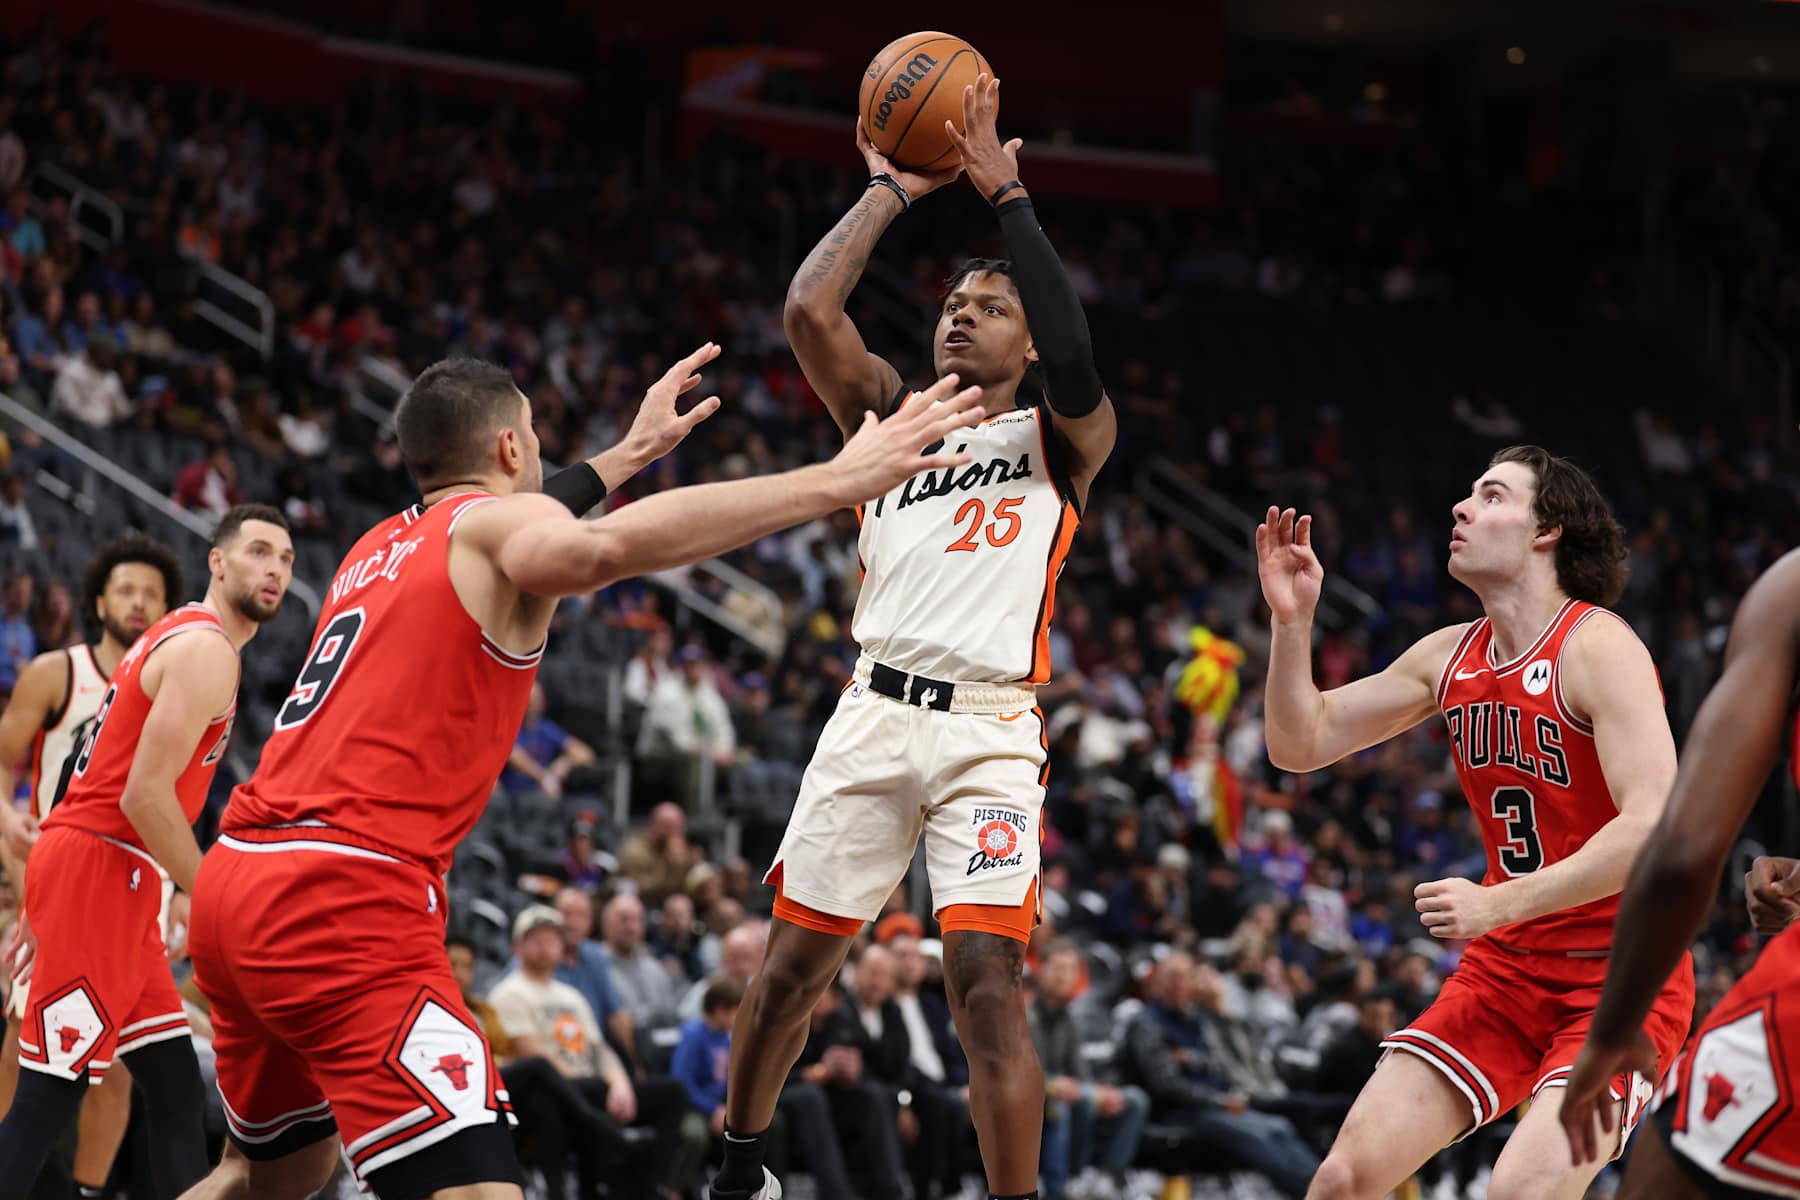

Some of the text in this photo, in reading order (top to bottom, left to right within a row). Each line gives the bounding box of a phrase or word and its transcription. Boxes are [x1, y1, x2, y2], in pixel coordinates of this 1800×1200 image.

[874, 53, 939, 131] Wilson
[944, 495, 1026, 553] 25
[274, 605, 366, 731] 9
[1445, 700, 1572, 788] BULLS
[973, 808, 1027, 832] PISTONS
[1492, 786, 1544, 877] 3
[966, 850, 1023, 876] Detroit
